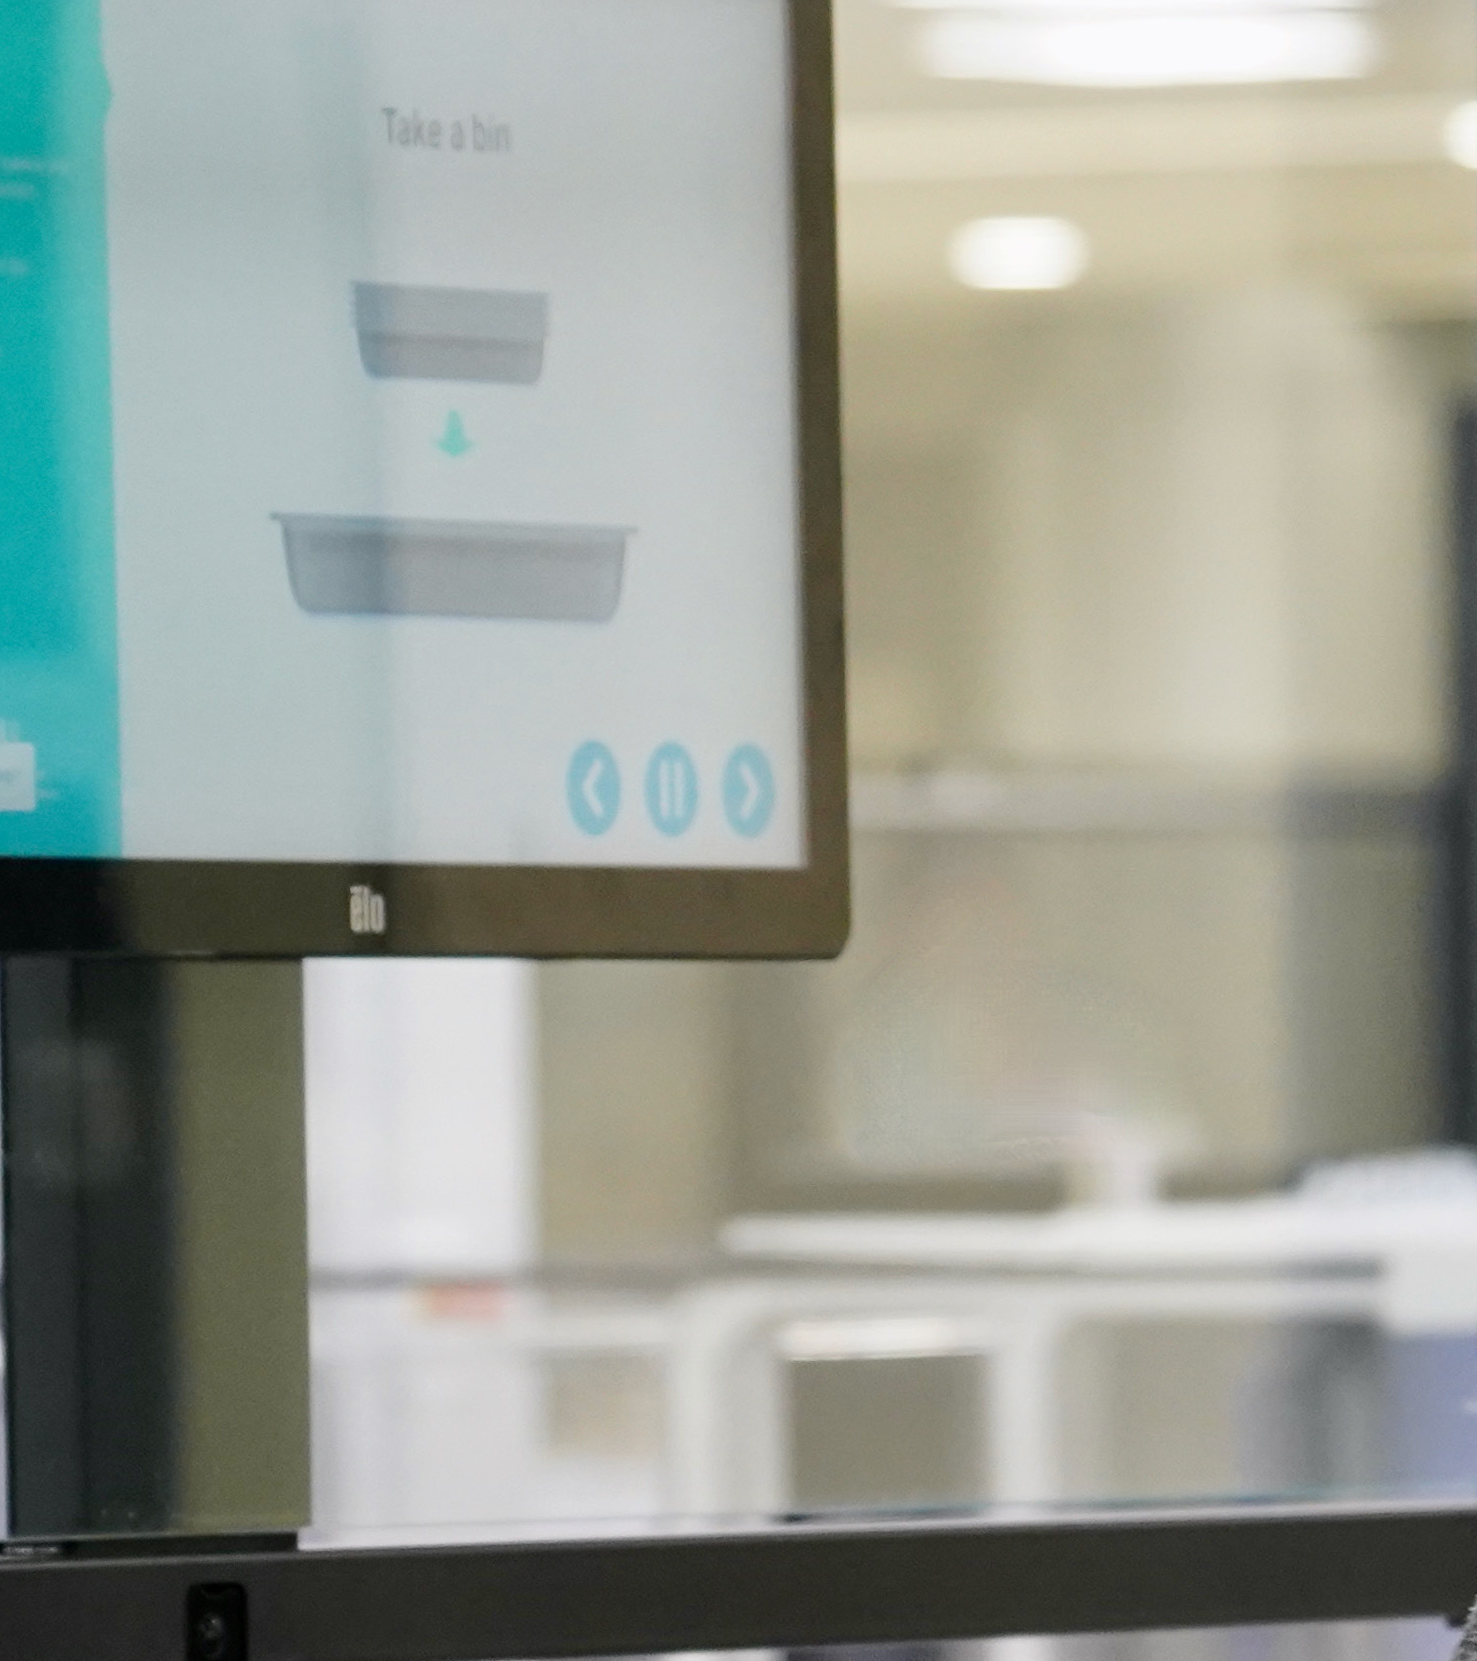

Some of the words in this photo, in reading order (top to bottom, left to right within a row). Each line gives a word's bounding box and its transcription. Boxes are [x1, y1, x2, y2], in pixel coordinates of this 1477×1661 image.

[381, 107, 441, 148] Take
[450, 119, 466, 151] a
[472, 113, 512, 153] bin
